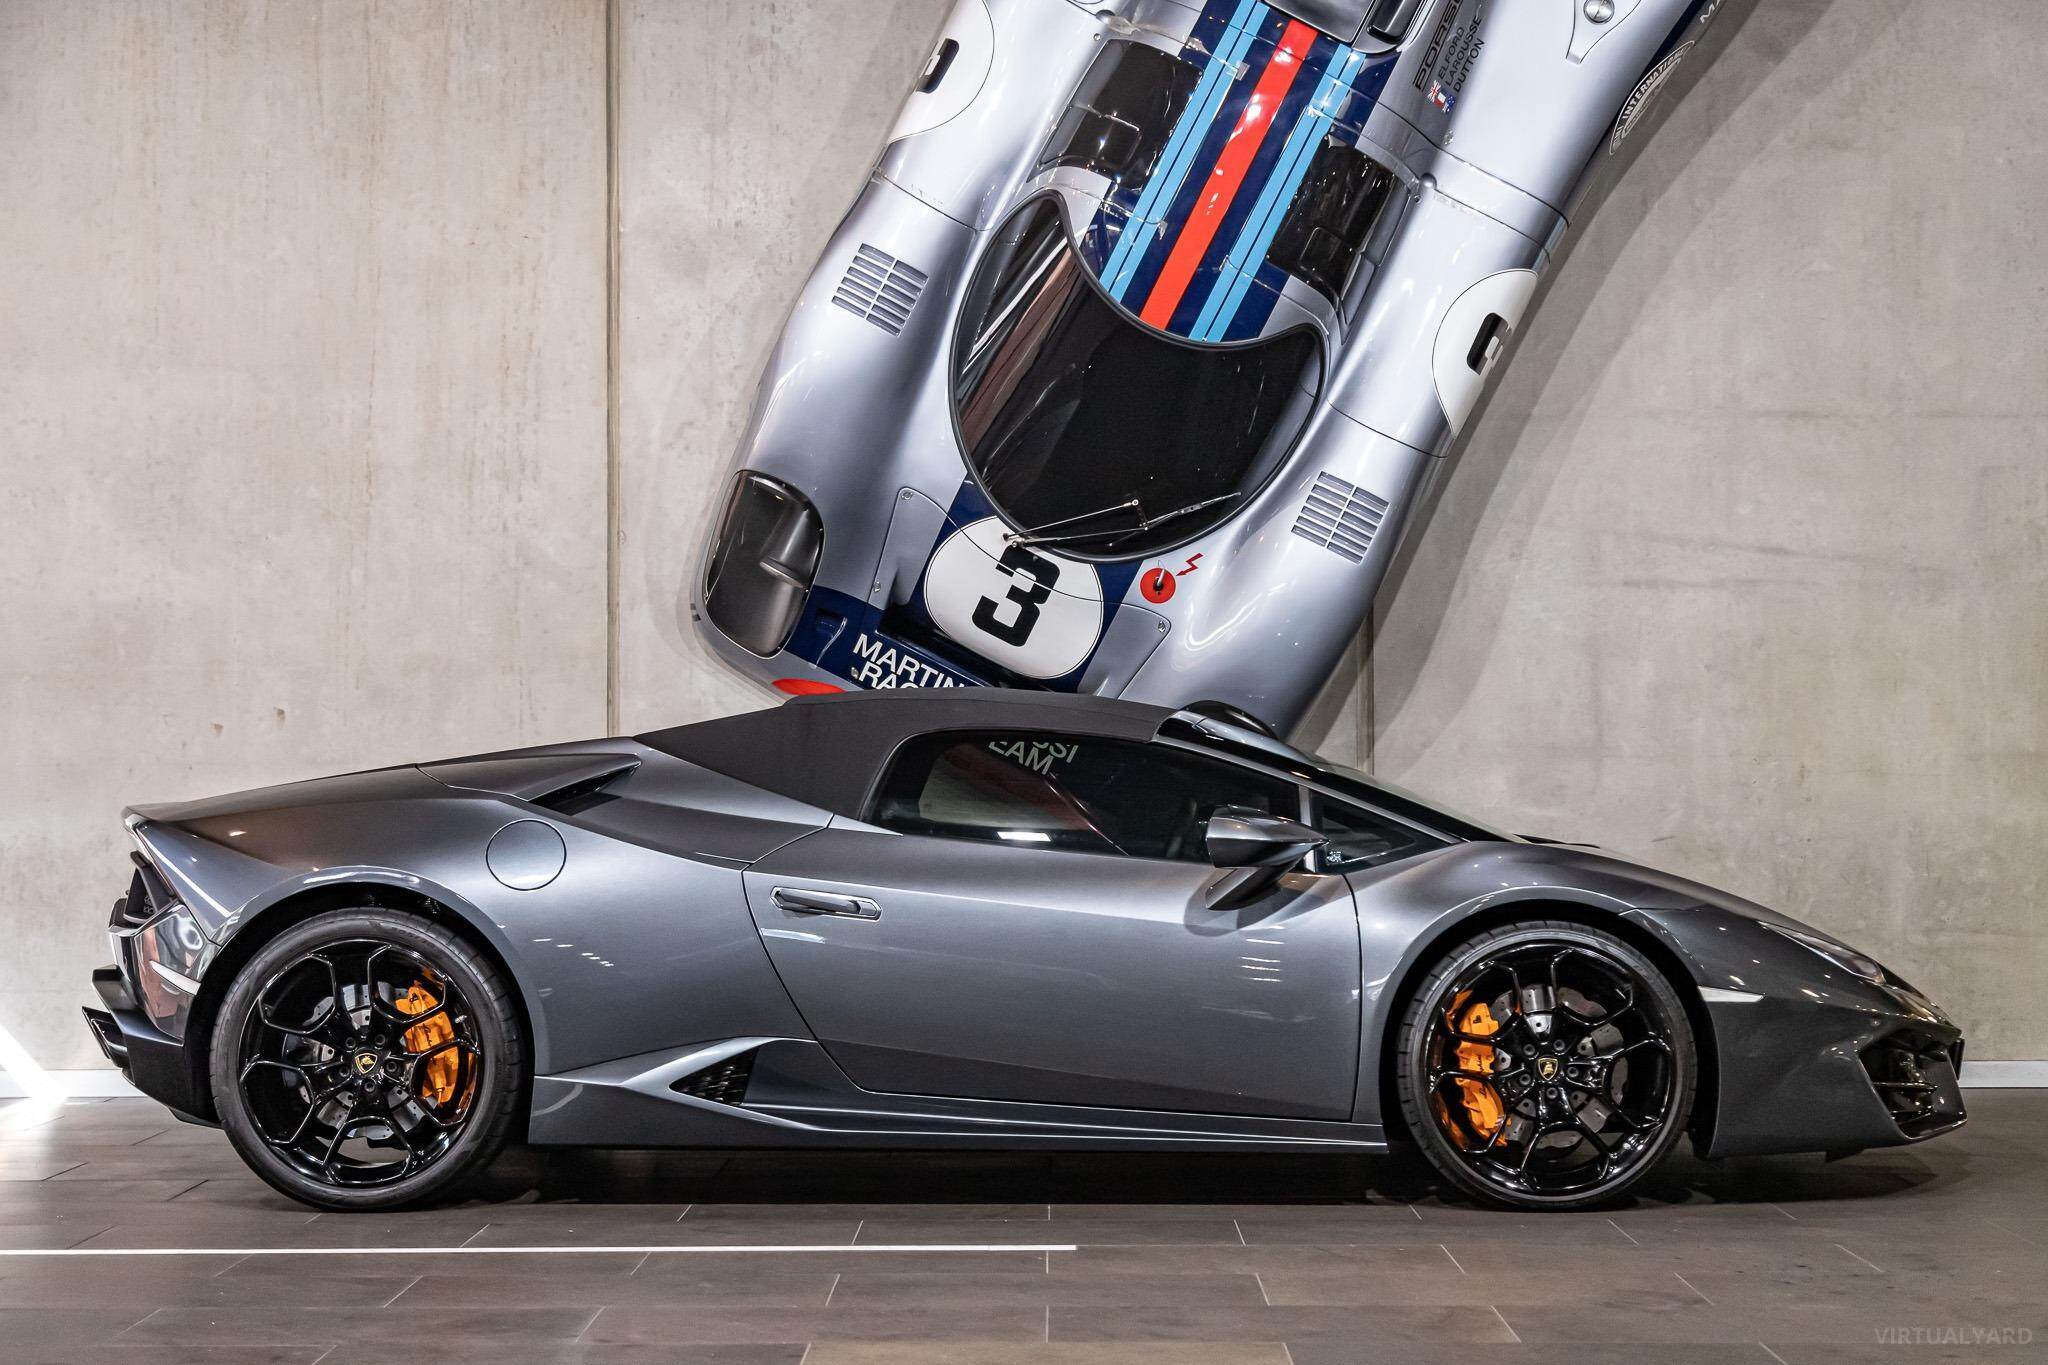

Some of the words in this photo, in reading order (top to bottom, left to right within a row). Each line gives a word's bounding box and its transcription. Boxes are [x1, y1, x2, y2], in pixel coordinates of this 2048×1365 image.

[1438, 26, 1465, 80] ELFORD
[1445, 15, 1482, 87] LAROUSSE
[1452, 37, 1485, 92] DUTTON
[971, 544, 1061, 648] 3
